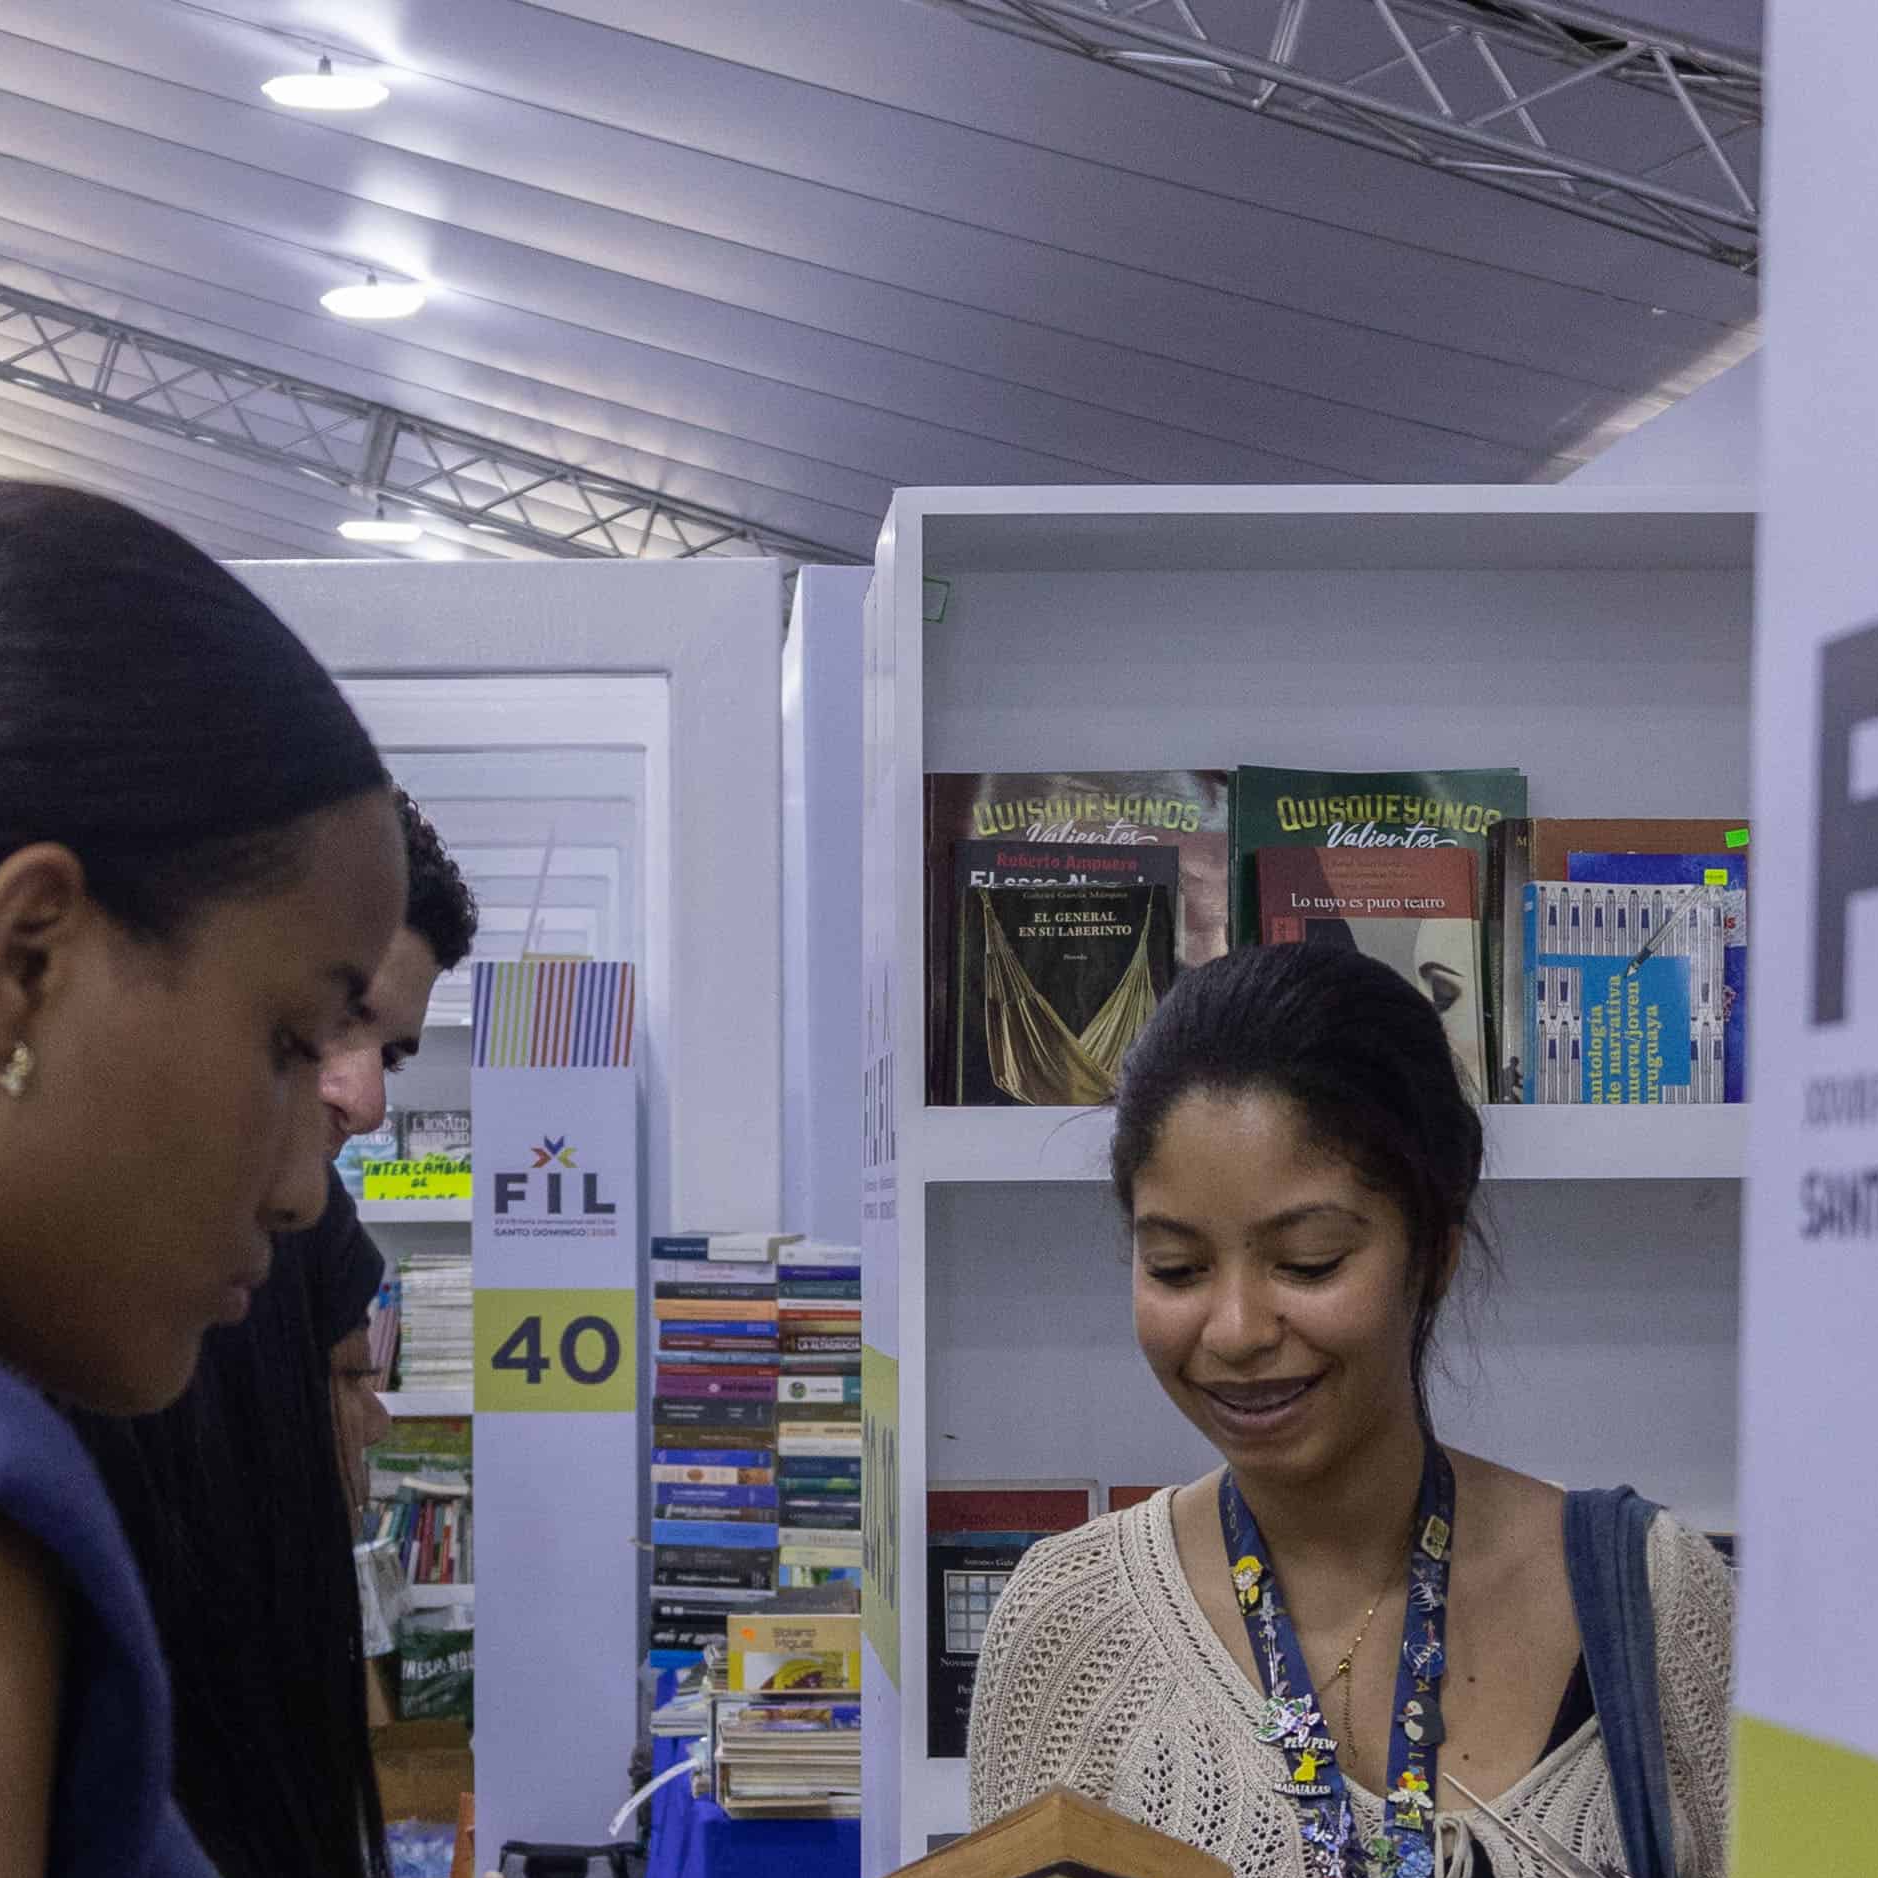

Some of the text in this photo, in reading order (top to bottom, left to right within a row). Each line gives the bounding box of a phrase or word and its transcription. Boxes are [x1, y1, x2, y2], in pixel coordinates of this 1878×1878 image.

[973, 794, 1201, 836] QUISQUEYANOS
[1276, 794, 1502, 836] QUISQUEYANOS
[1026, 817, 1159, 845] Valientes
[1327, 820, 1458, 848] Valientes
[997, 851, 1140, 872] Roberto Ampuero
[1034, 911, 1116, 923] EL GENERAL
[1291, 893, 1446, 913] Lo tuyo es puro teatro
[1019, 925, 1132, 937] EN SU LABERINTO
[1605, 974, 1622, 1104] de narrativa
[494, 1173, 616, 1214] FIL
[493, 1228, 529, 1237] SANTO
[532, 1228, 586, 1237] DOMINGO
[491, 1315, 622, 1386] 40
